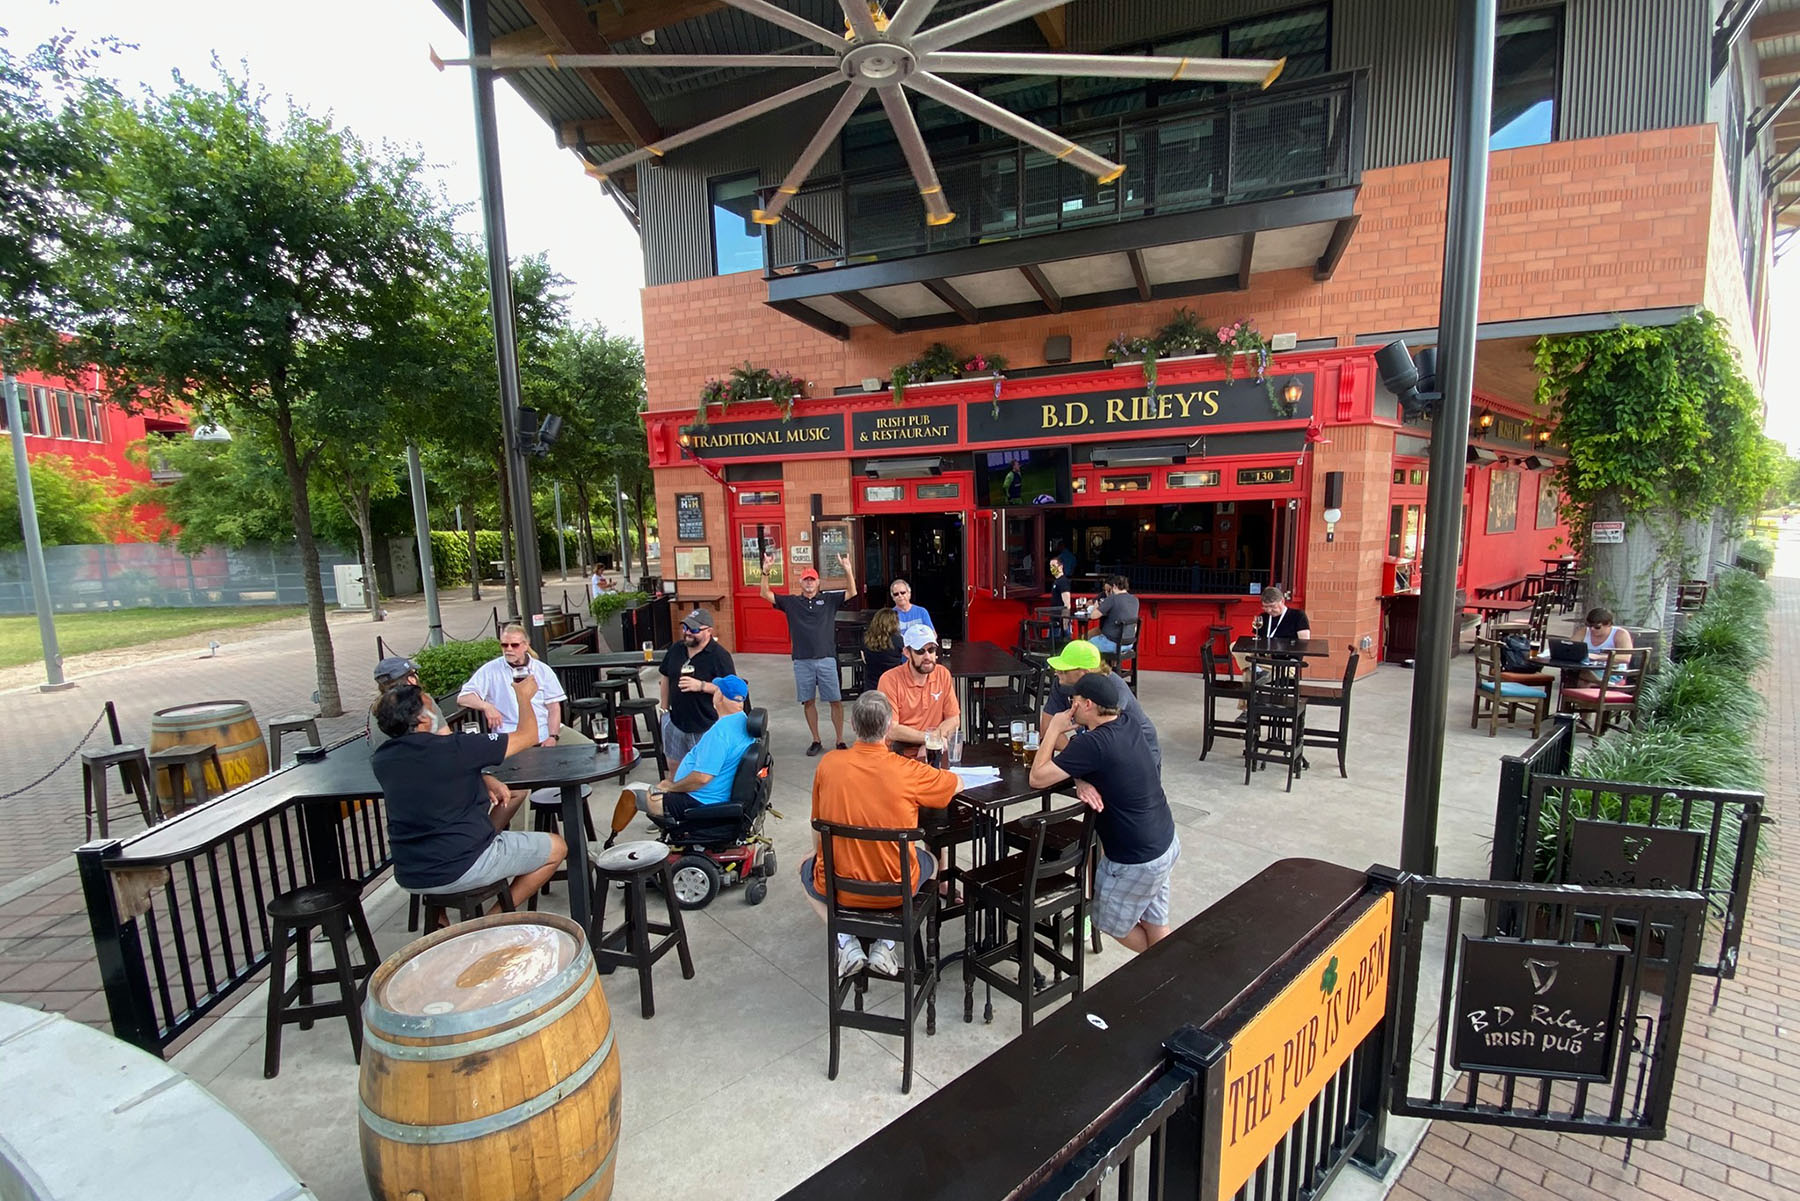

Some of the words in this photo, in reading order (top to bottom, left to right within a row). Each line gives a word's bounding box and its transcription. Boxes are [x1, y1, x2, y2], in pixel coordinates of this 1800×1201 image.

[1041, 402, 1095, 428] B.D.
[1106, 390, 1220, 423] RILEY'S
[876, 418, 906, 429] IRISH
[909, 415, 931, 427] PUB
[693, 431, 783, 449] TRADITIONAL
[786, 427, 831, 442] MUSIC
[859, 432, 869, 442] &
[872, 425, 949, 441] RESTAURANT
[1256, 471, 1274, 481] 130
[1228, 1053, 1275, 1147] THE
[1280, 1015, 1318, 1104] PUB
[1323, 988, 1343, 1058] IS
[1345, 925, 1388, 1025] OPEN
